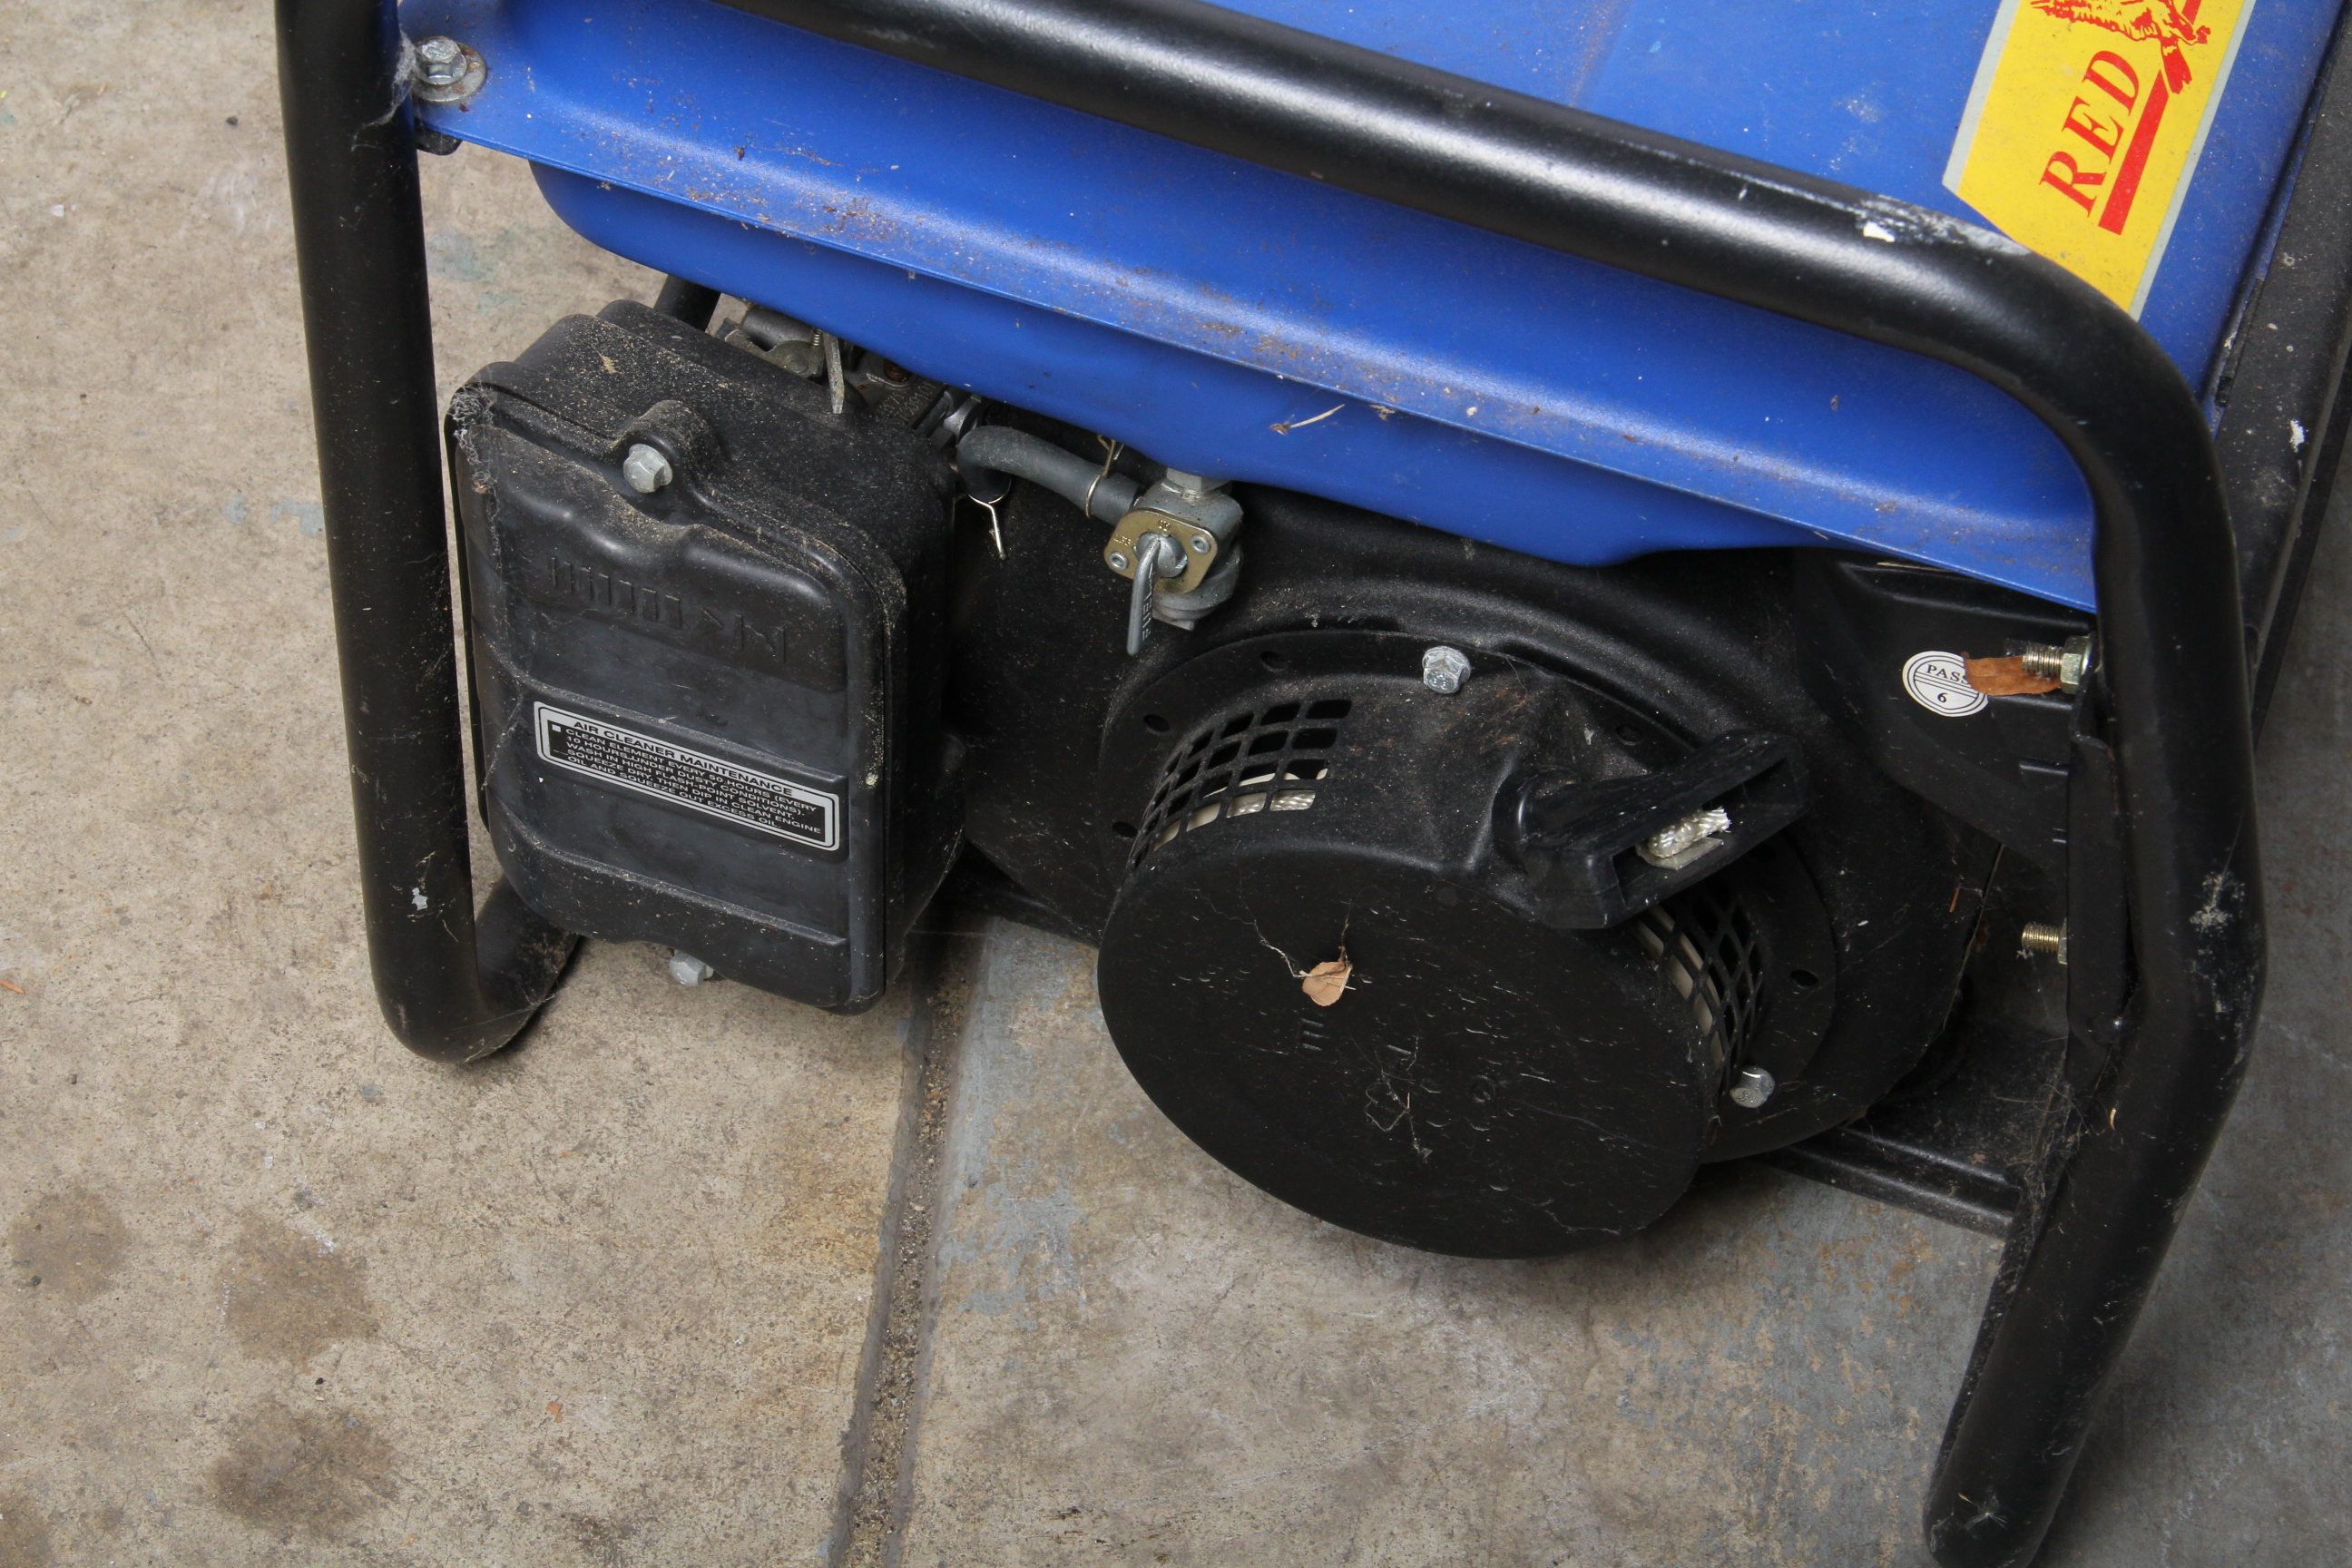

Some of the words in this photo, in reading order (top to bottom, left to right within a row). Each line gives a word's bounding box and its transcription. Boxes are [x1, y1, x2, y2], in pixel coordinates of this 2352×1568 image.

[2039, 50, 2140, 218] RED
[1936, 692, 1948, 703] 6
[565, 729, 604, 744] CLEAN
[609, 742, 664, 762] ELEMENT
[668, 761, 705, 776] EVERY
[727, 779, 769, 798] HOURS
[775, 795, 816, 812] (EVERY
[566, 742, 602, 757] WASH
[622, 760, 651, 772] HIGH
[655, 770, 734, 799] FLASH-POINT
[567, 756, 586, 765] OIL
[590, 763, 615, 774] AND
[619, 772, 675, 793] SQUEEZE
[679, 791, 703, 803] OUT
[708, 800, 754, 819] EXCESS
[567, 750, 623, 770] SQUEEZE
[657, 778, 688, 790] THEN
[691, 789, 711, 799] DIP
[731, 801, 770, 818] CLEAN
[775, 815, 820, 834] ENGINE
[573, 721, 598, 733] AIR
[603, 731, 674, 758] CLEANER
[680, 755, 791, 796] MAINTENANCE
[584, 741, 627, 758] HOURS
[632, 757, 673, 772] UNDER
[677, 771, 717, 788] DUSTY
